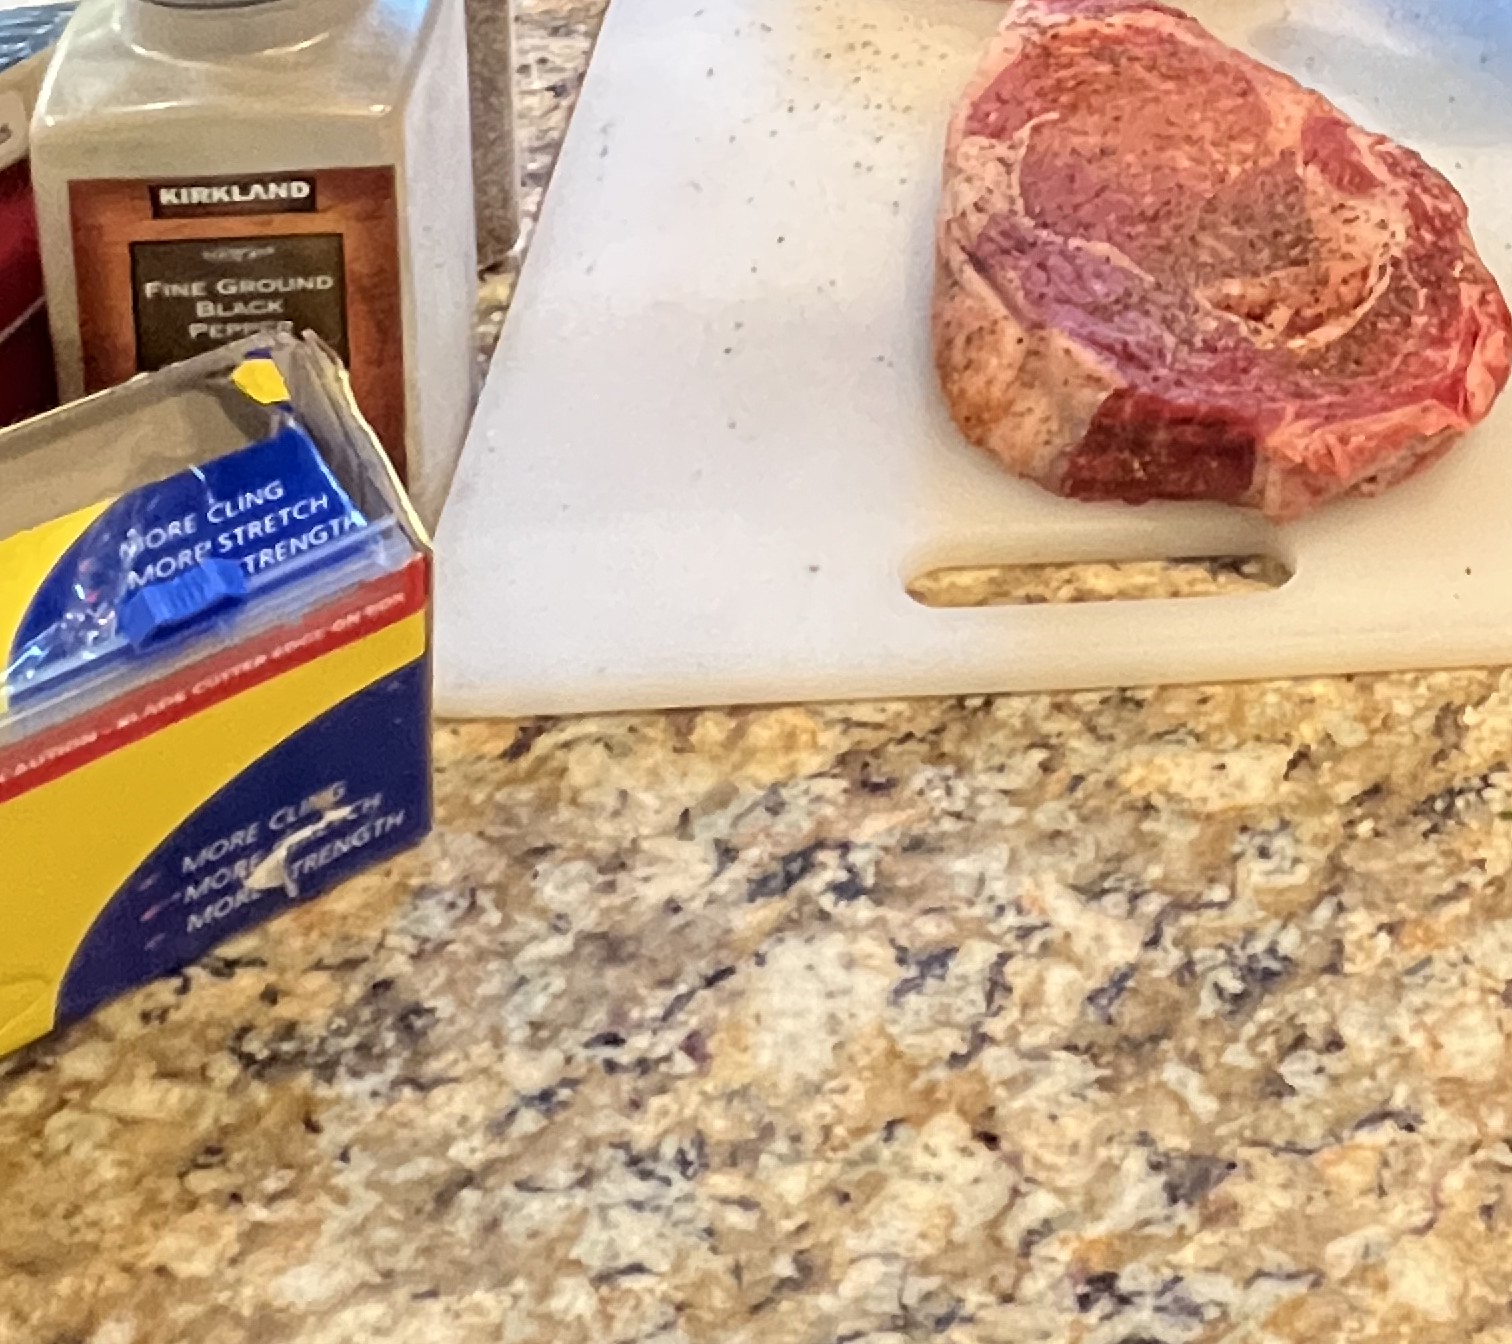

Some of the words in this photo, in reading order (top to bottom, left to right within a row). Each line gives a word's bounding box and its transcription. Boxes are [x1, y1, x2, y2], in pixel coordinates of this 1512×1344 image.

[158, 180, 311, 205] KIRKLAND
[144, 280, 207, 299] FINE
[216, 275, 334, 296] GROUND
[195, 299, 284, 318] BLACK
[118, 512, 198, 560] MORE
[206, 479, 285, 524] CLING
[217, 493, 329, 554] STRETCH
[242, 516, 367, 575] TRENGTH
[182, 821, 260, 874] MORE
[291, 810, 407, 880] TRENGTH
